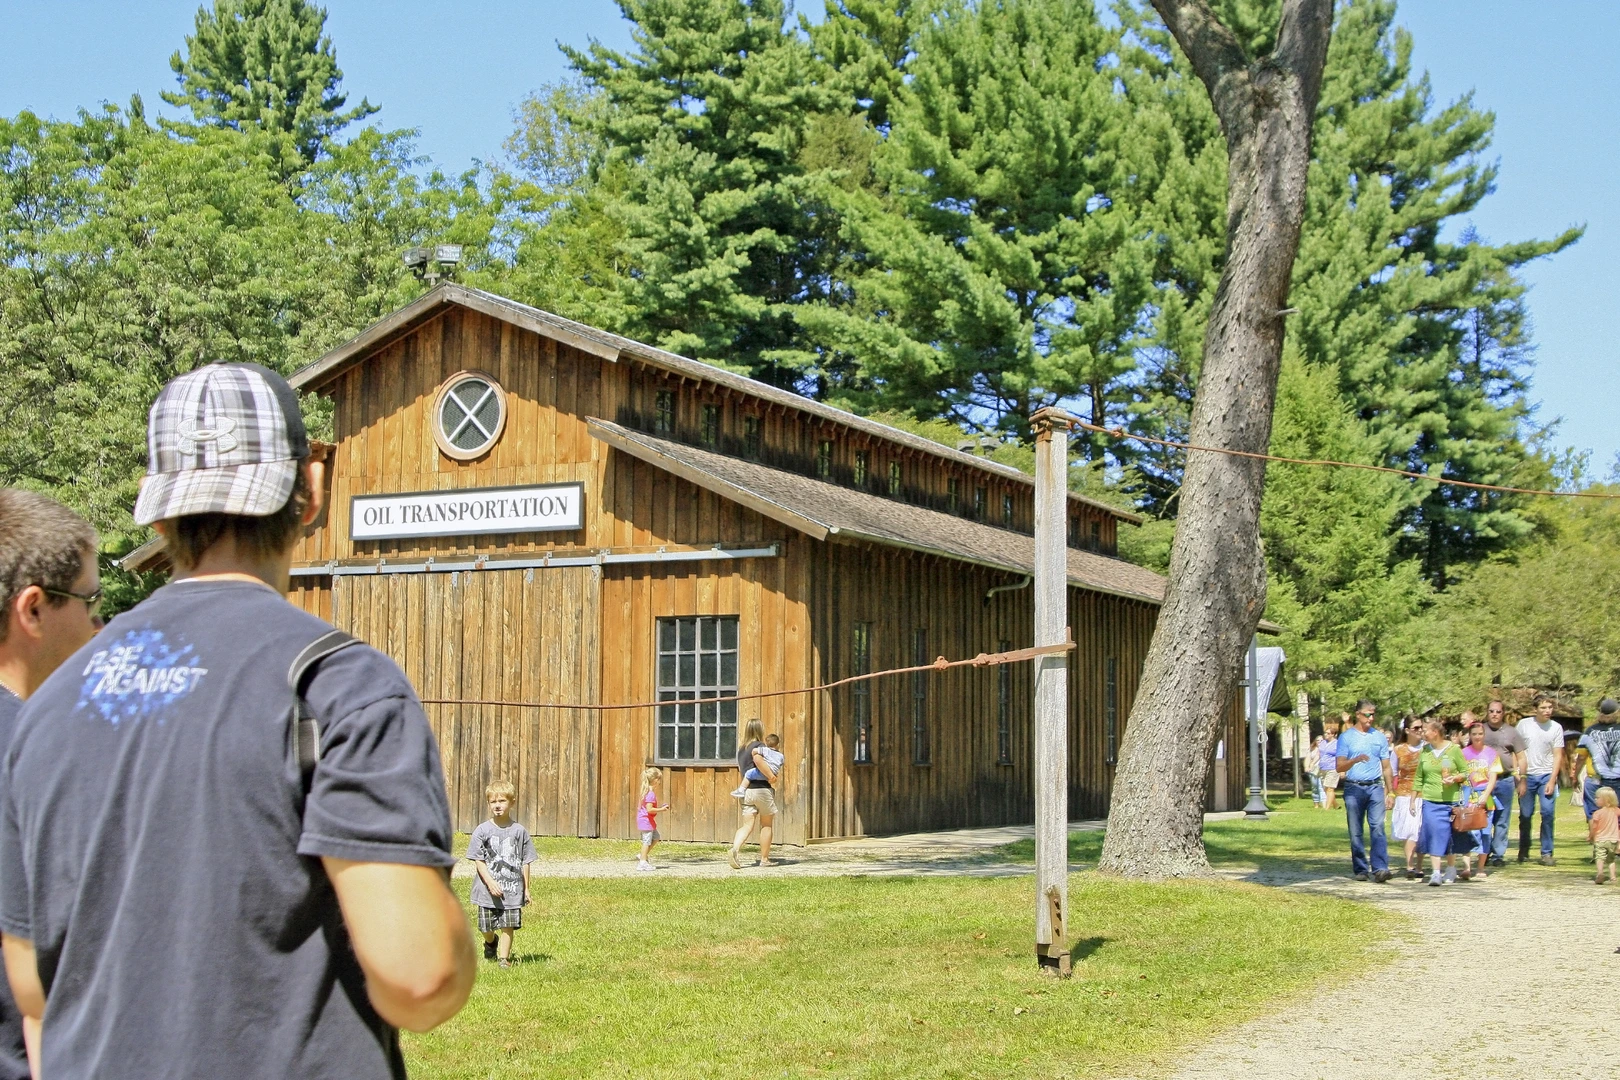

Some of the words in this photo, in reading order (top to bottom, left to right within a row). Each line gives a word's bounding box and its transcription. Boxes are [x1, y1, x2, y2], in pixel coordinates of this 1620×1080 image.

[364, 506, 394, 526] OIL
[400, 495, 568, 524] TRANSPORTATION
[91, 666, 208, 696] AGAINST
